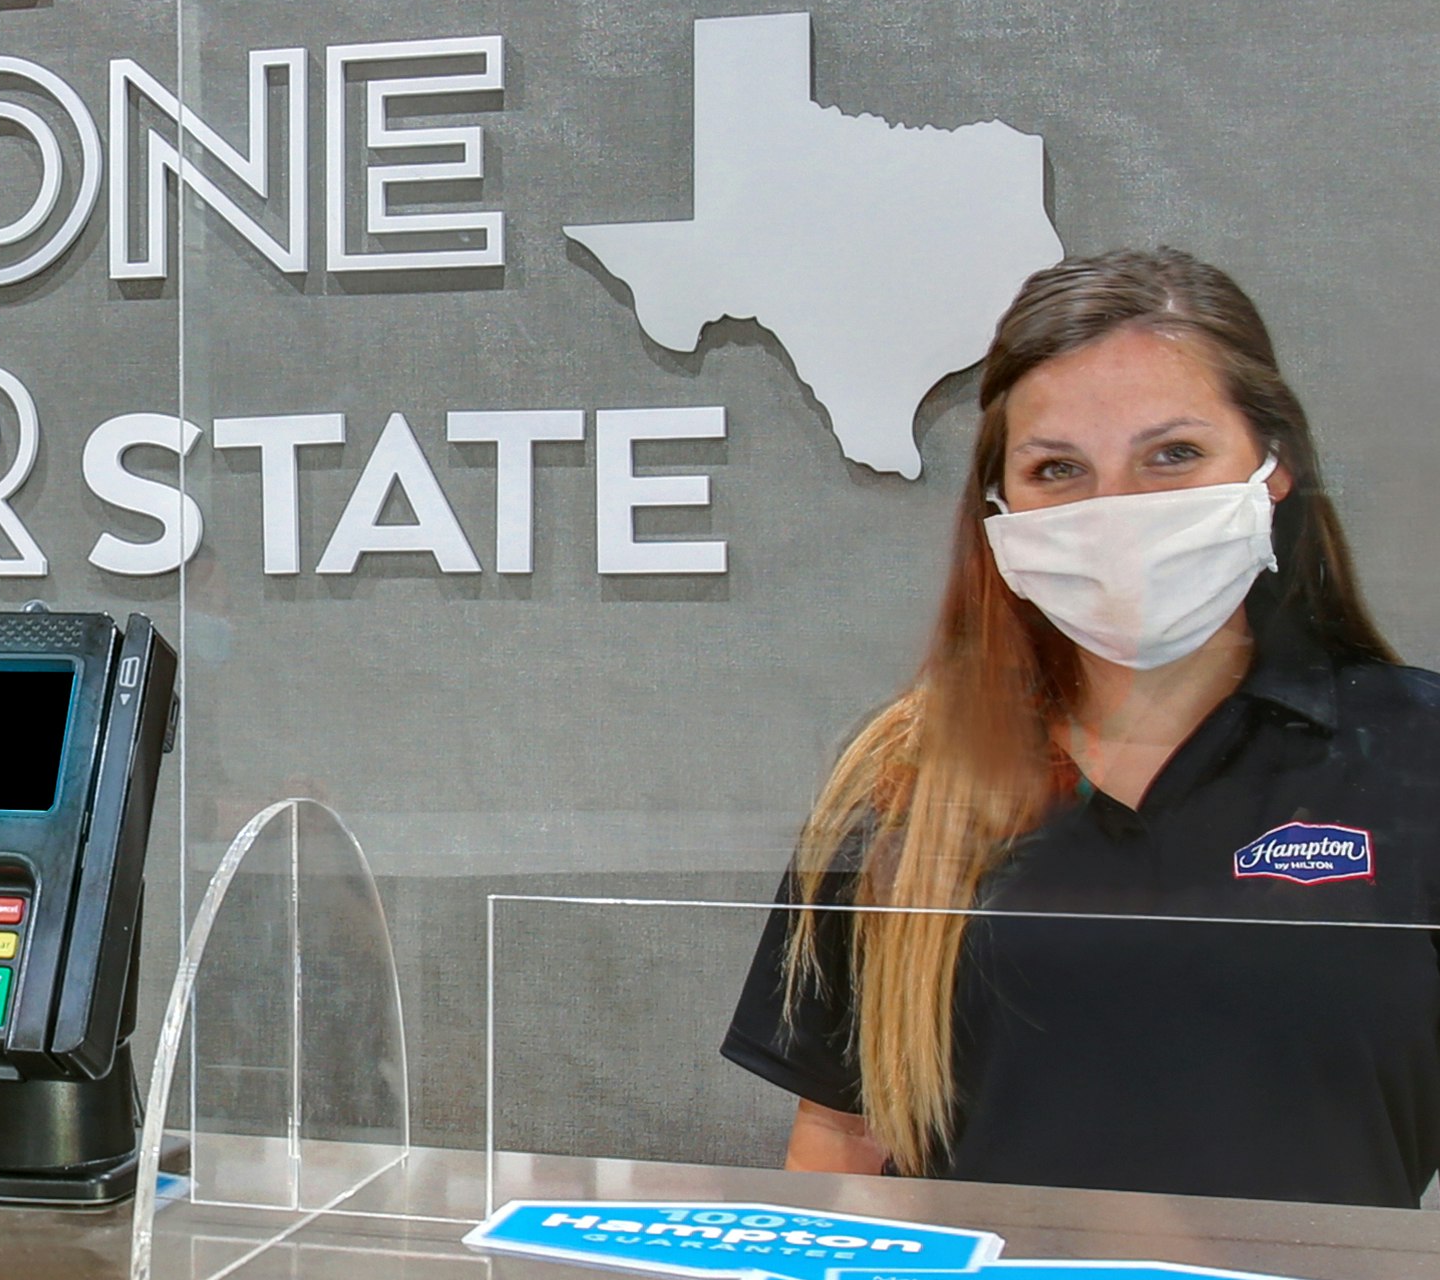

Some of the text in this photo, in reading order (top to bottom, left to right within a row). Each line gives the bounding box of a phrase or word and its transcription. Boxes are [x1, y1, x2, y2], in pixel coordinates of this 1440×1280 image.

[82, 405, 728, 576] STATE
[1239, 837, 1366, 869] Hampton
[1274, 861, 1334, 871] by HILTON
[541, 1212, 922, 1254] Hampton
[658, 1209, 835, 1229] 100%
[582, 1233, 856, 1260] GUARANTEE
